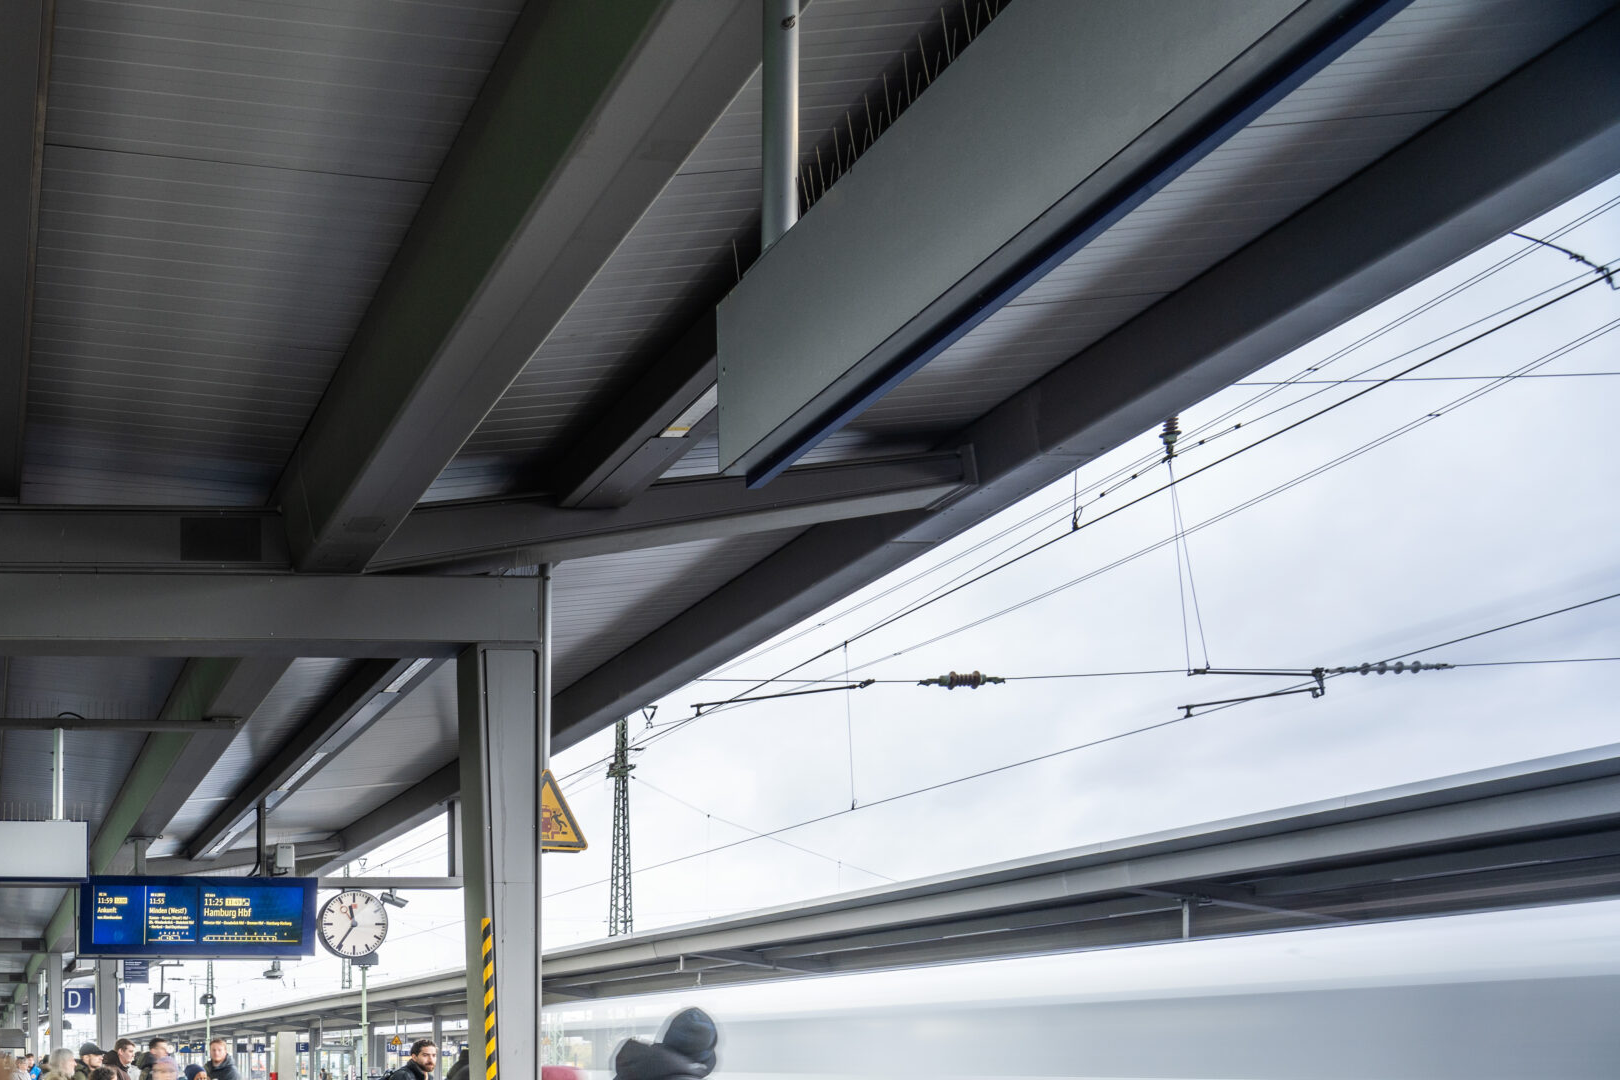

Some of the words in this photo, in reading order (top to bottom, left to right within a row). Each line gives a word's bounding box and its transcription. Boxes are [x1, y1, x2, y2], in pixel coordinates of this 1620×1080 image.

[204, 898, 224, 906] 11:25
[203, 908, 237, 918] Hamburg
[237, 908, 252, 917] Hbf
[68, 990, 82, 1008] D
[299, 1043, 305, 1051] E
